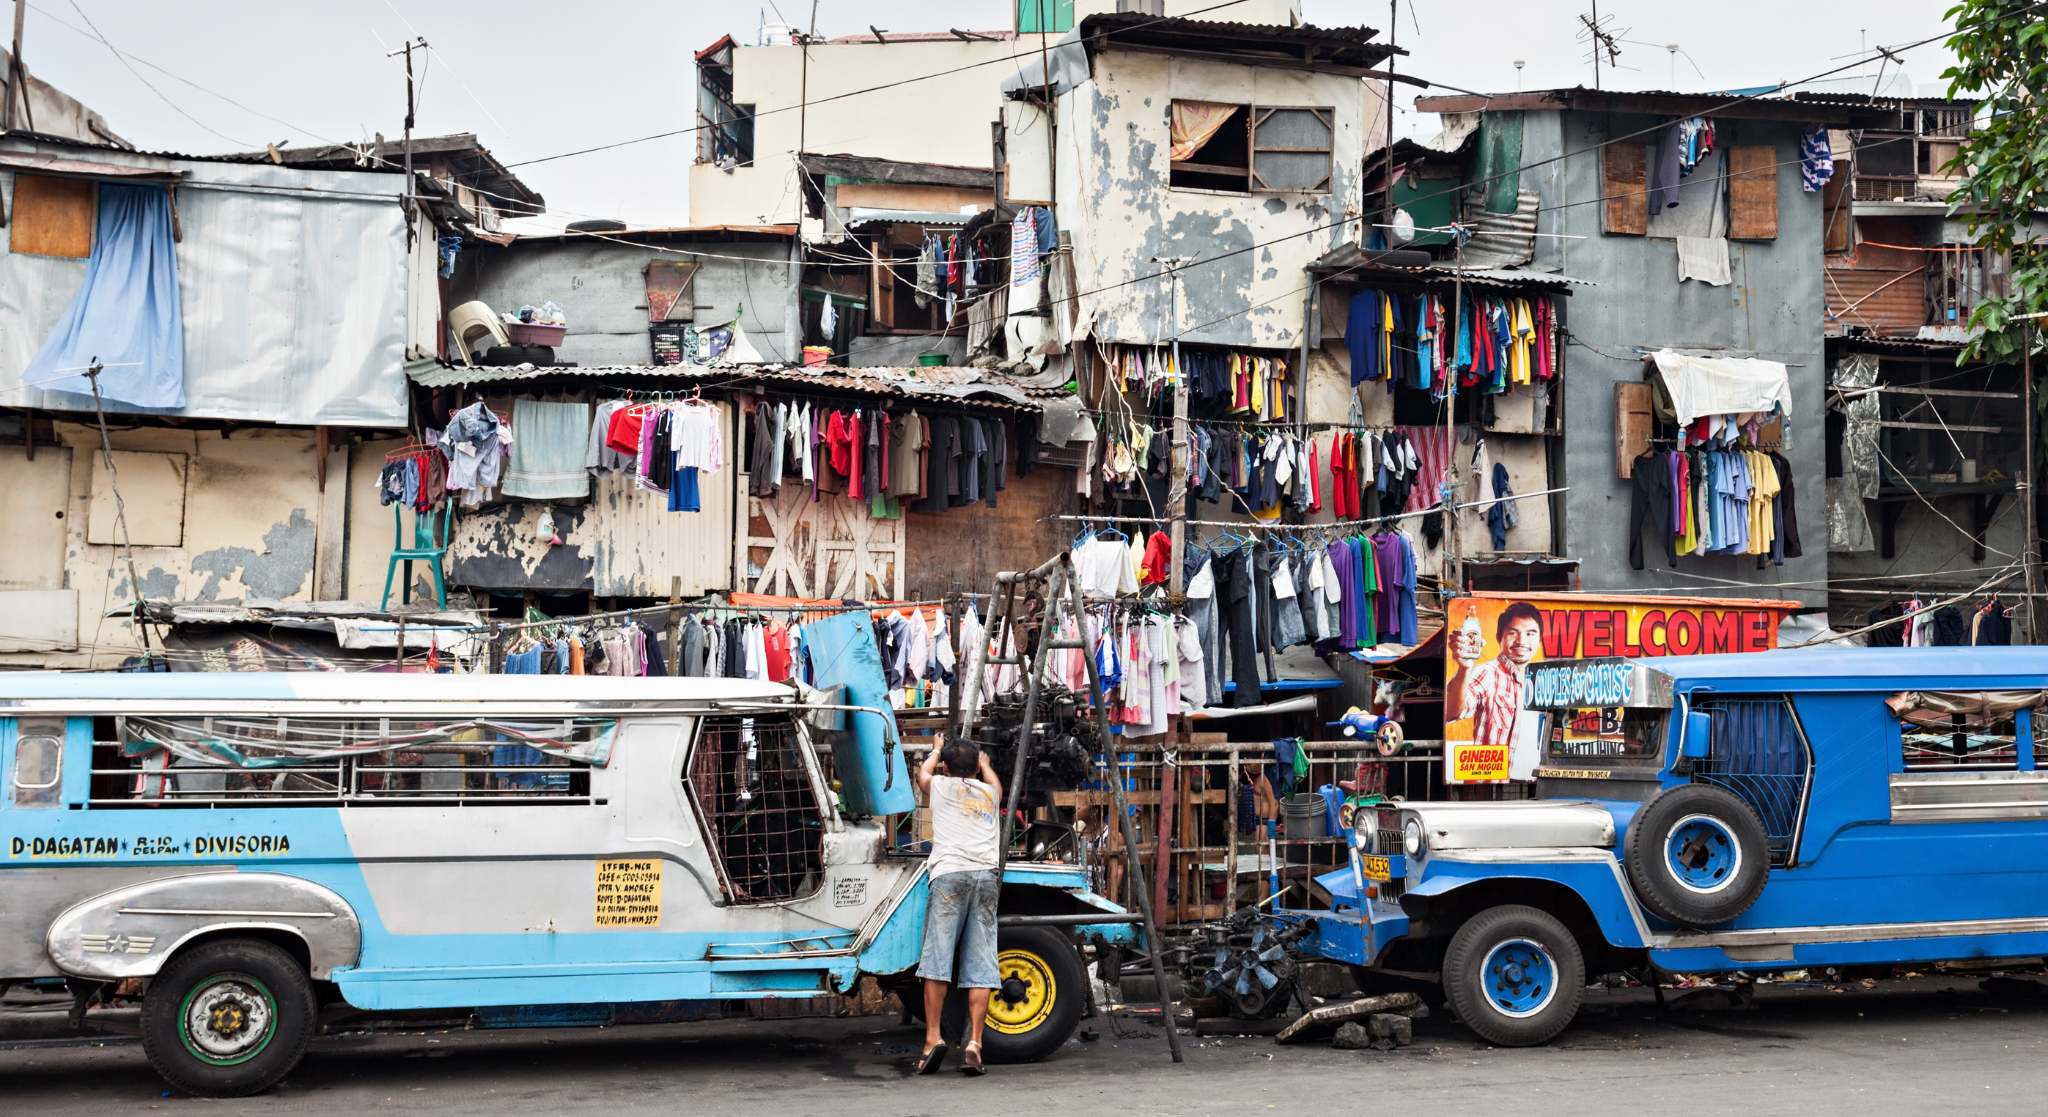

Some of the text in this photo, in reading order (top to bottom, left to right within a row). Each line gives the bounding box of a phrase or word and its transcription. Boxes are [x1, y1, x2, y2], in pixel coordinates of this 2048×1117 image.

[1540, 609, 1770, 658] WELCOME
[1535, 663, 1634, 707] COUPLES for CHRIST
[1600, 707, 1624, 735] B
[1459, 749, 1504, 763] GINEBRA
[1459, 763, 1504, 772] SAN MIGUEL
[10, 836, 118, 859] D-DAGATAN
[193, 834, 291, 857] DIVISORIA
[132, 846, 180, 858] DELPAN
[598, 872, 615, 882] CASE
[624, 883, 655, 893] AMORES
